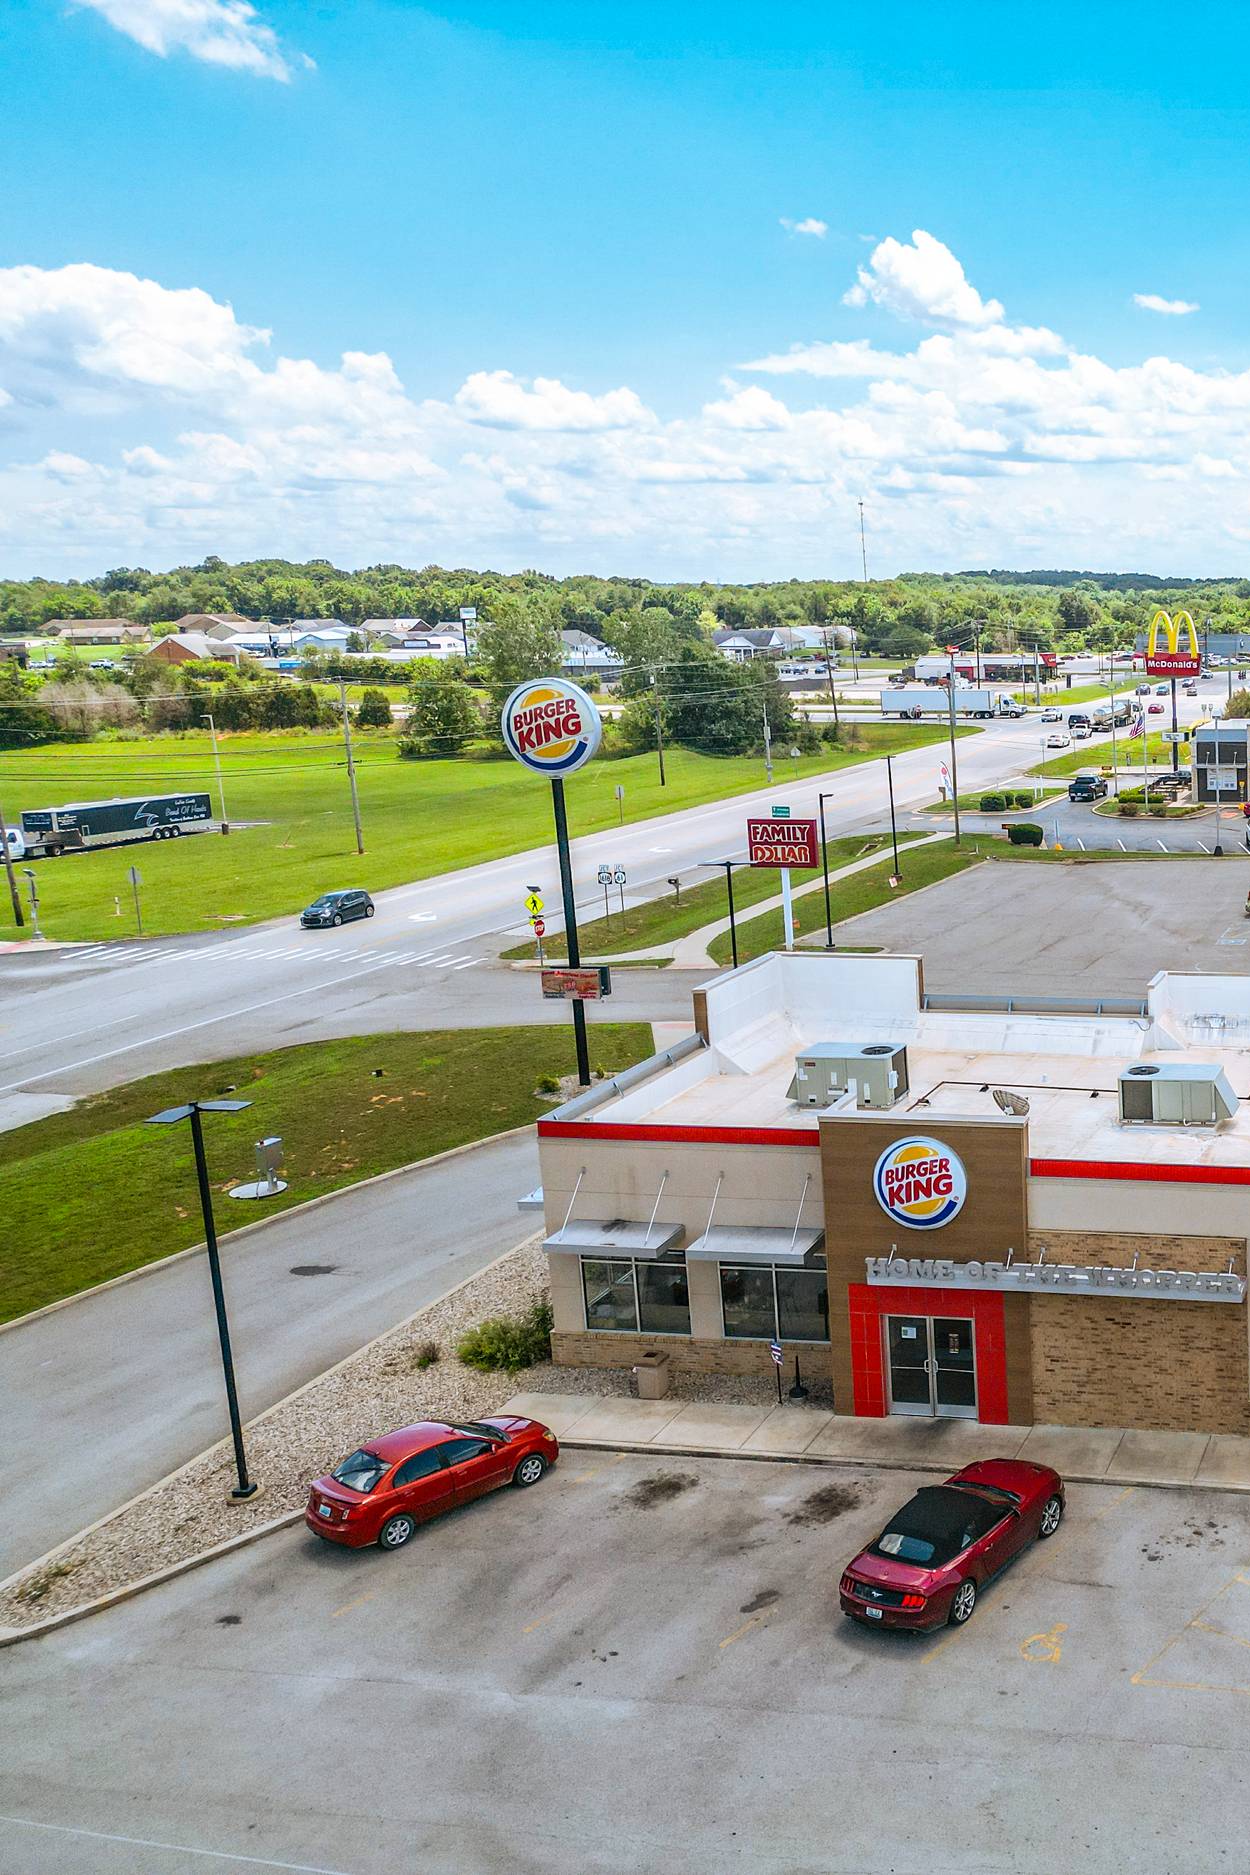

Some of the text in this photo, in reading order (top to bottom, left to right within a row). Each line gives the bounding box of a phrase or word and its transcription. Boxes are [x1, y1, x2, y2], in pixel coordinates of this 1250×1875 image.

[1147, 660, 1198, 669] McDonald's
[513, 698, 577, 732] BURGER
[517, 713, 582, 753] KING
[750, 824, 810, 843] FAMILY
[751, 844, 811, 864] DOLLAR
[884, 1157, 950, 1186] BURGER
[888, 1173, 953, 1208] KING
[864, 1256, 1243, 1296] HOME OF THE WHOPPER
